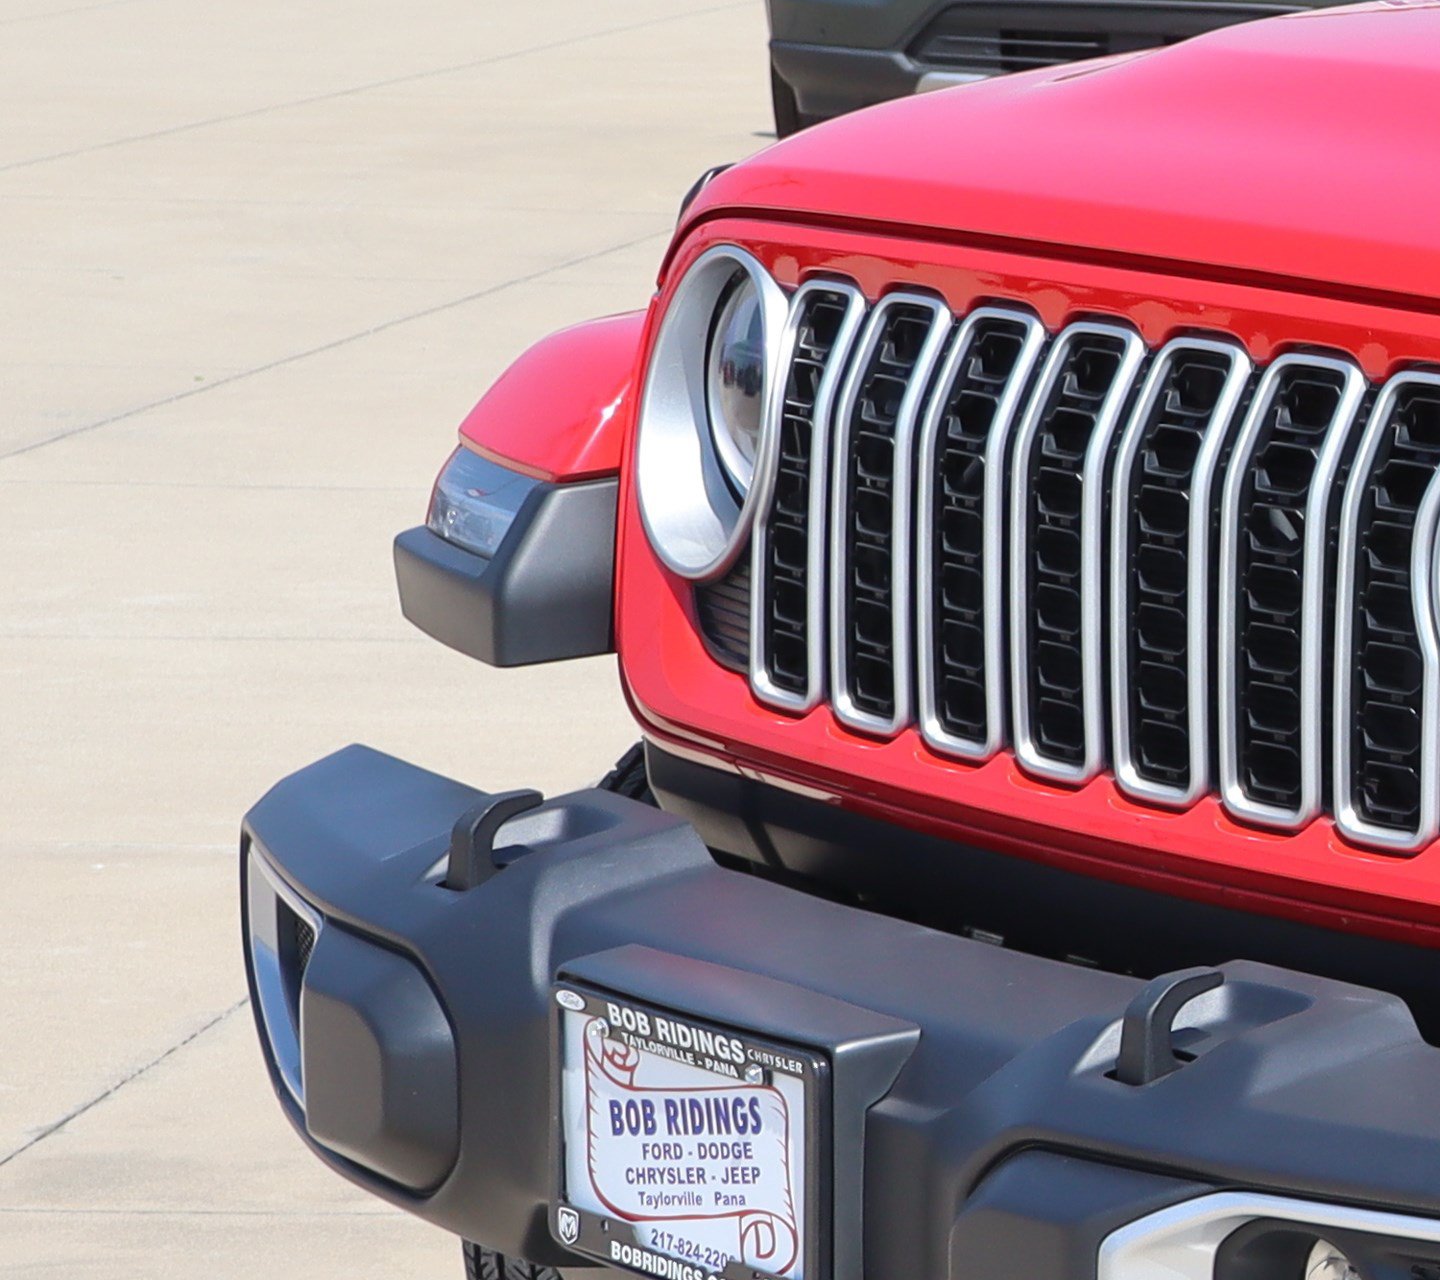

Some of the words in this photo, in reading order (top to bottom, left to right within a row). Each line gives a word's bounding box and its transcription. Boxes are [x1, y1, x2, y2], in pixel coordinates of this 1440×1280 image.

[606, 1002, 652, 1036] BOB
[655, 1017, 746, 1064] RIDINGS
[621, 1031, 695, 1066] TAYLORVILLE
[705, 1058, 739, 1079] PANA
[747, 1048, 803, 1074] CHRYSLER
[608, 1098, 656, 1137] BOB
[665, 1096, 763, 1136] RIDINGS
[641, 1142, 683, 1161] FORD
[697, 1141, 754, 1160] DODGE
[625, 1167, 707, 1185] CHRYSLER
[721, 1166, 761, 1185] JEEP
[638, 1191, 703, 1207] Taylorville
[714, 1192, 746, 1206] Pana
